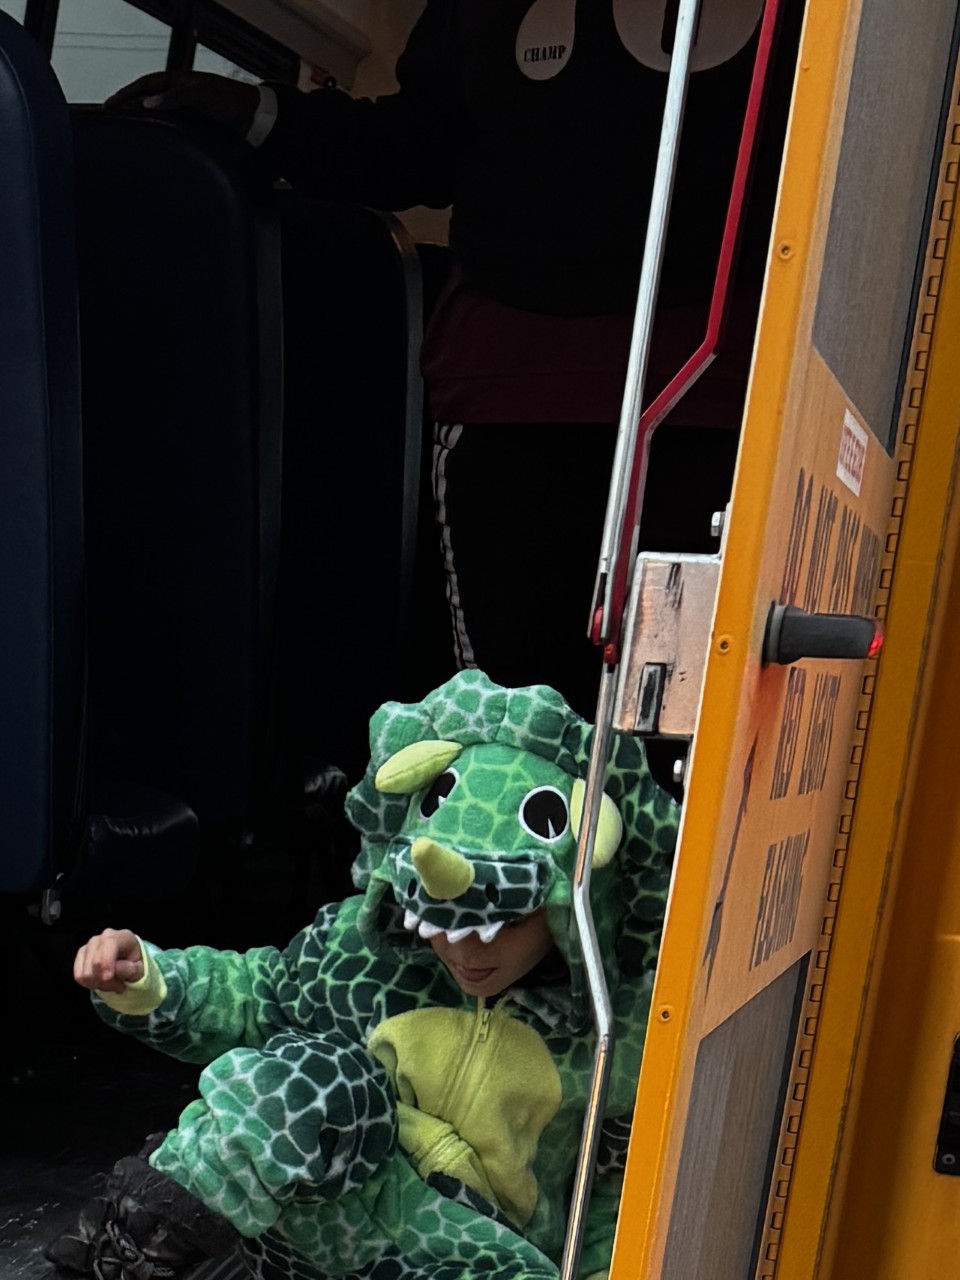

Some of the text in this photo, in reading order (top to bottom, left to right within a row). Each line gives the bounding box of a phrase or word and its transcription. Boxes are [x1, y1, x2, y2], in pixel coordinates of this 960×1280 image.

[523, 44, 567, 62] CHAMP
[779, 467, 813, 606] DO
[803, 485, 838, 614] NOT
[770, 667, 841, 800] RED LIGHTS
[749, 827, 811, 971] FLASHING
